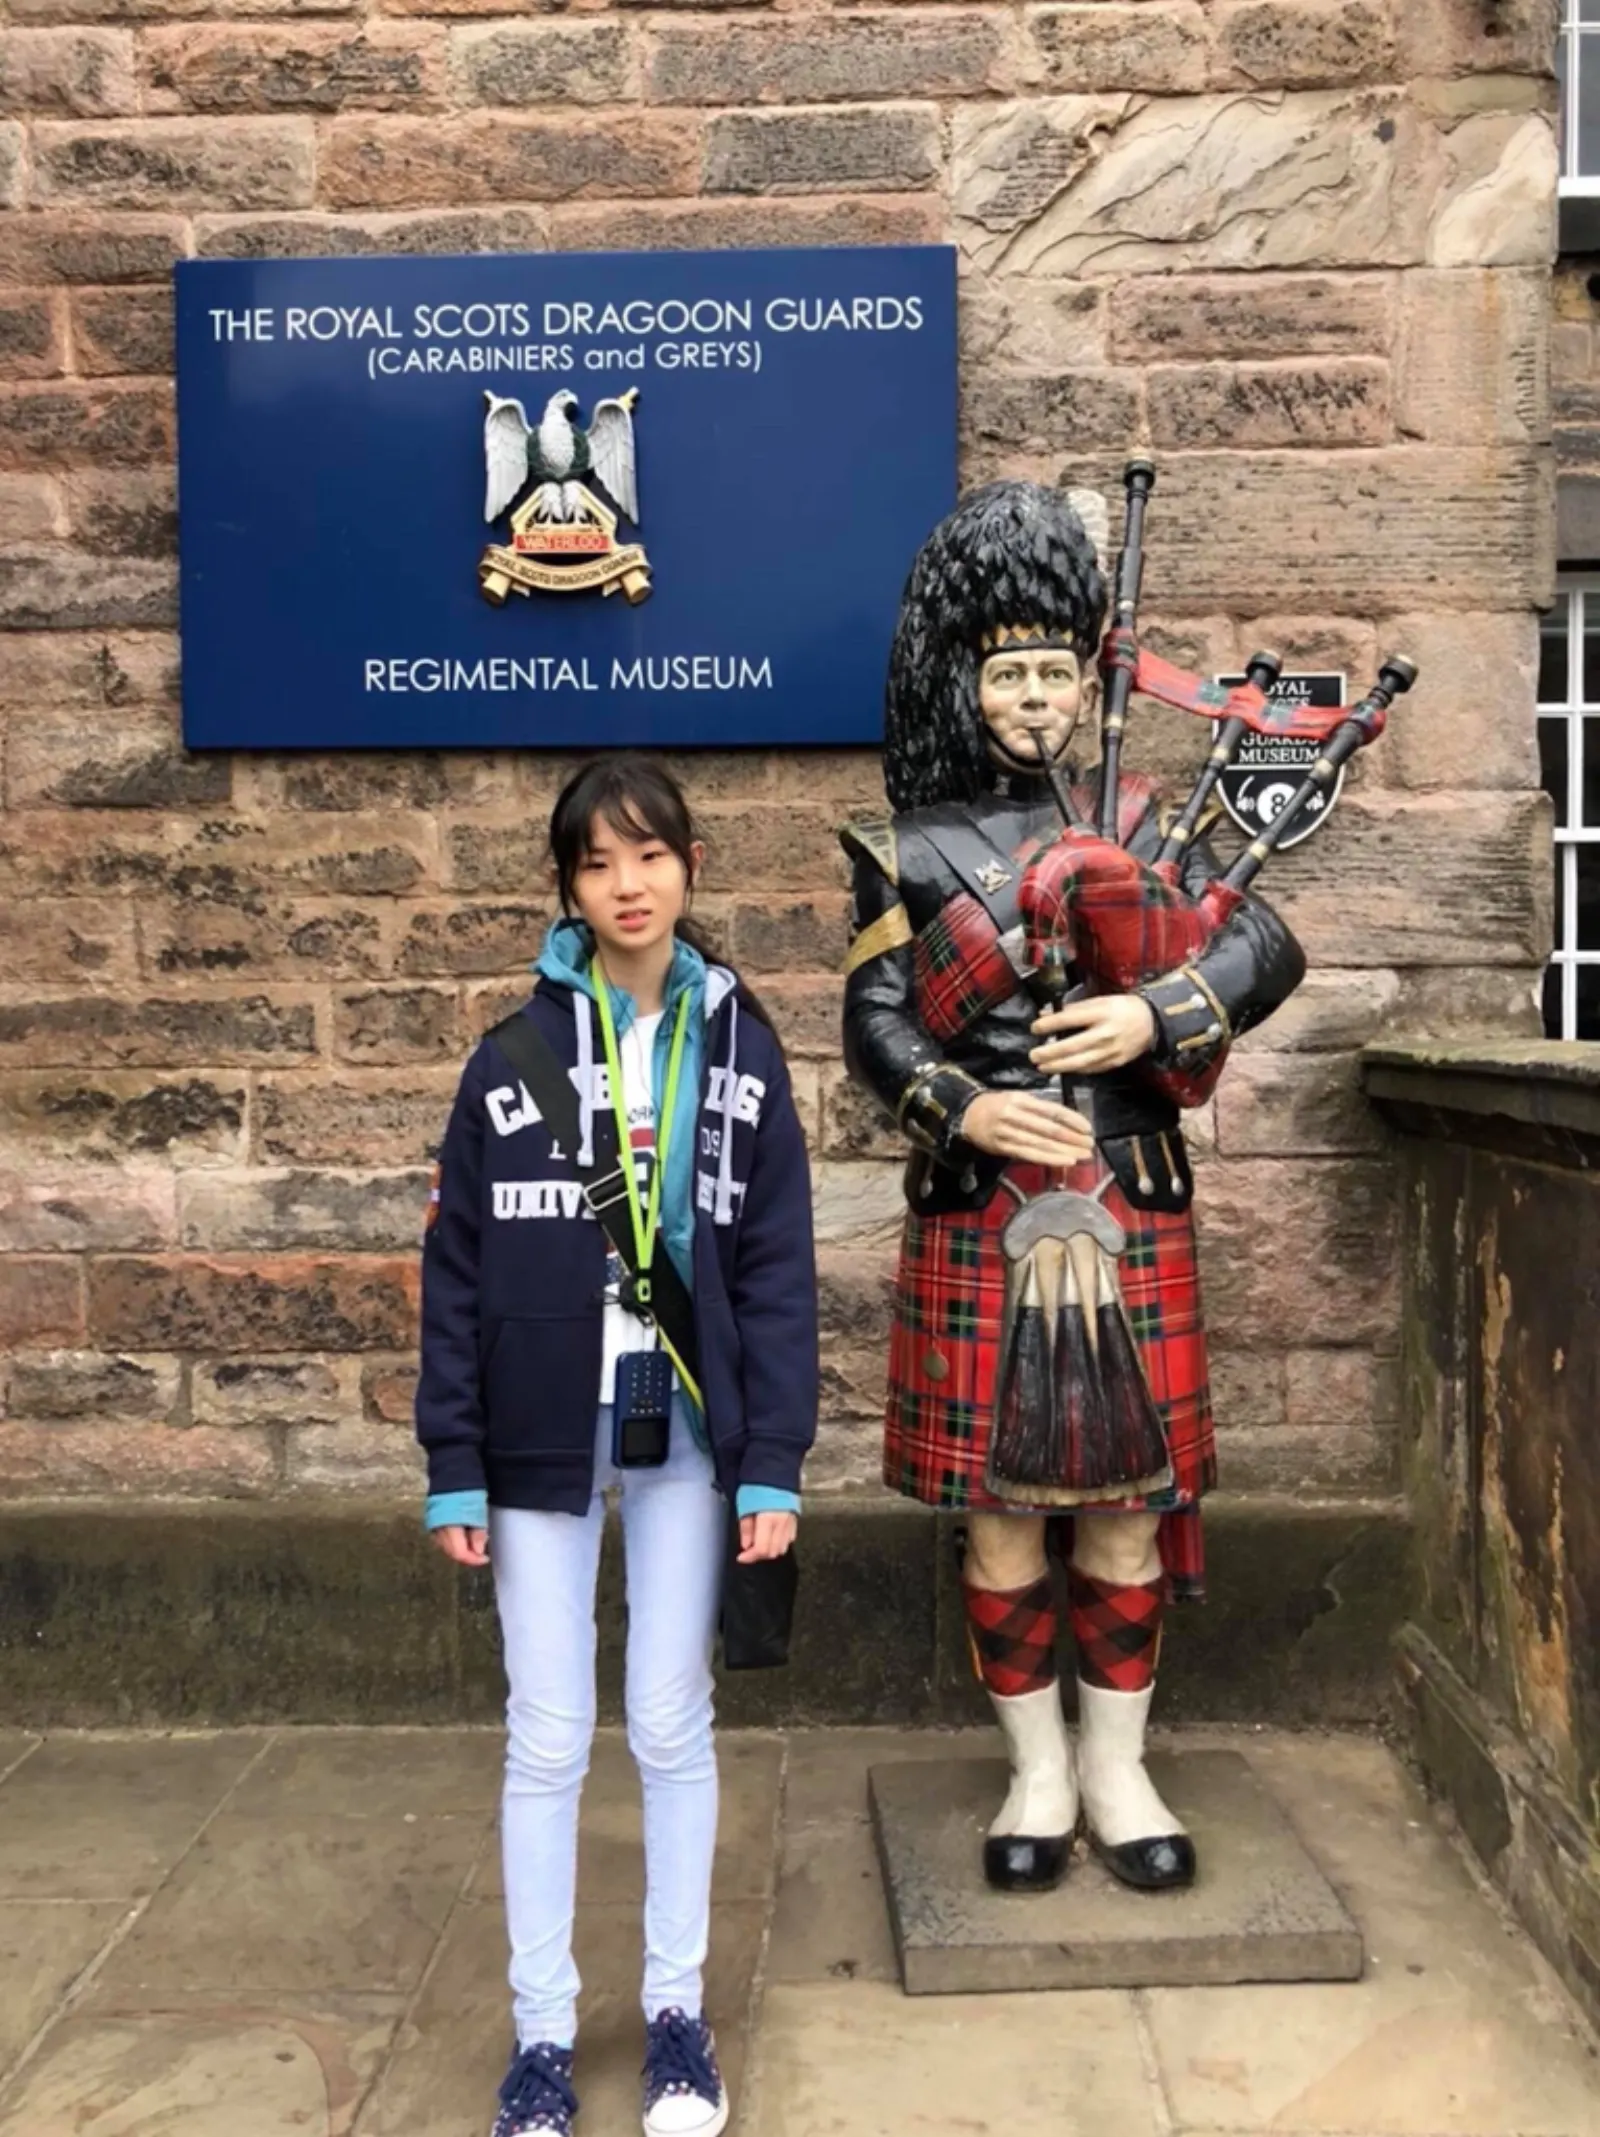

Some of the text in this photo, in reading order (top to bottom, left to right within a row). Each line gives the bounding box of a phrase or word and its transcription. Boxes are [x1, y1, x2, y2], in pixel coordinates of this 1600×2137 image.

[209, 296, 924, 342] THE ROYAL SCOTS DRAGOON GUARDS
[368, 340, 761, 380] (CARABINIERS and GREYS)
[522, 534, 602, 550] WATERLOO
[365, 656, 773, 692] REGIMENTAL MUSEUM
[1238, 747, 1320, 763] MUSEUM
[491, 1179, 597, 1221] UNIV
